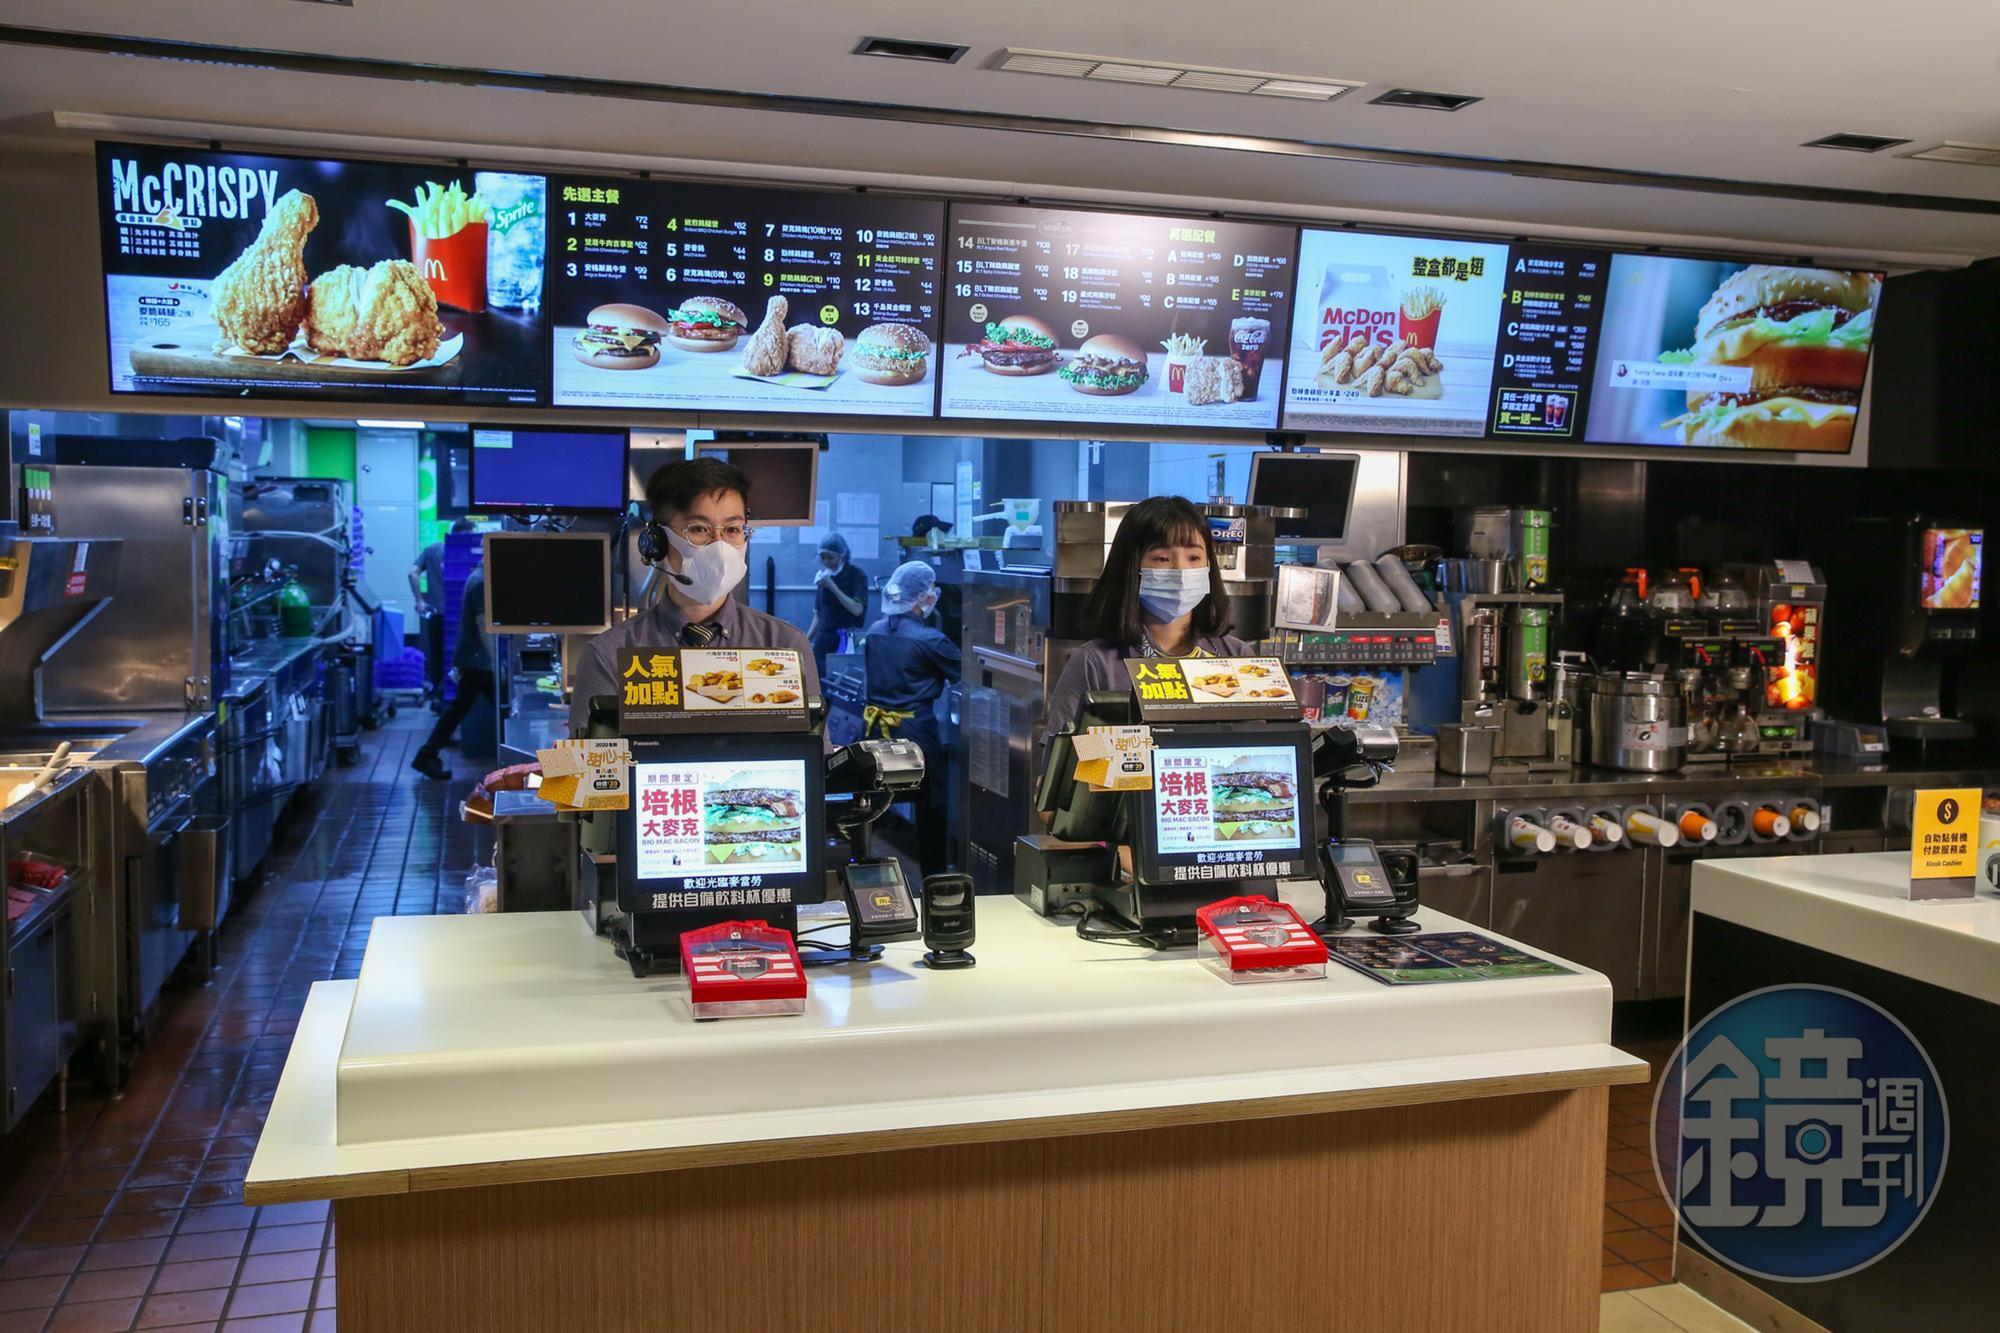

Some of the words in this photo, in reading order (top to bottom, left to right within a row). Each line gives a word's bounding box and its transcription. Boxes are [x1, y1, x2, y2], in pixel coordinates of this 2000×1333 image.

[112, 159, 278, 219] McCRISPY
[563, 186, 620, 205] 先選主餐
[496, 202, 535, 229] Sprite
[568, 212, 576, 226] 1
[667, 219, 678, 231] 4
[765, 224, 775, 237] 7
[856, 230, 873, 243] 10
[958, 237, 974, 249] 14
[567, 238, 577, 251] 2
[667, 243, 677, 256] 5
[1066, 244, 1080, 255] 17
[764, 249, 774, 262] 8
[857, 255, 870, 267] 11
[1168, 250, 1177, 262] A
[1234, 255, 1244, 267] D
[567, 263, 577, 277] 3
[957, 260, 973, 273] 15
[1413, 257, 1485, 281] 整盒都是翅
[1515, 259, 1526, 273] A
[666, 268, 677, 282] 6
[1064, 267, 1079, 279] 18
[1167, 273, 1176, 285] B
[764, 274, 774, 286] 9
[855, 278, 871, 291] 12
[955, 284, 971, 297] 16
[1062, 290, 1077, 303] 19
[1232, 289, 1240, 301] E
[1512, 290, 1522, 304] B
[1164, 296, 1174, 309] C
[854, 303, 870, 316] 13
[1323, 308, 1396, 325] McDon
[1507, 322, 1519, 336] C
[1503, 354, 1515, 368] D
[1500, 412, 1541, 425] 買一送一
[1211, 530, 1244, 538] OREO
[623, 655, 678, 679] 人氣
[1136, 663, 1182, 680] 人氣
[624, 682, 679, 705] 加點
[1139, 682, 1189, 700] 加點
[1116, 735, 1159, 751] 甜心卡
[587, 749, 639, 767] 甜心卡
[1164, 758, 1202, 767] 期間限定
[648, 773, 694, 784] 期間限定
[1160, 772, 1208, 797] 培根
[642, 789, 699, 816] 培根
[1161, 798, 1209, 816] 大麥克
[642, 818, 699, 838] 大麥克
[1924, 833, 1968, 843] 自助點餐機
[1924, 845, 1967, 856] 付款服務處
[1174, 862, 1292, 881] 提供自備飲料杯優惠
[652, 888, 792, 910] 提供自備飲料杯優惠
